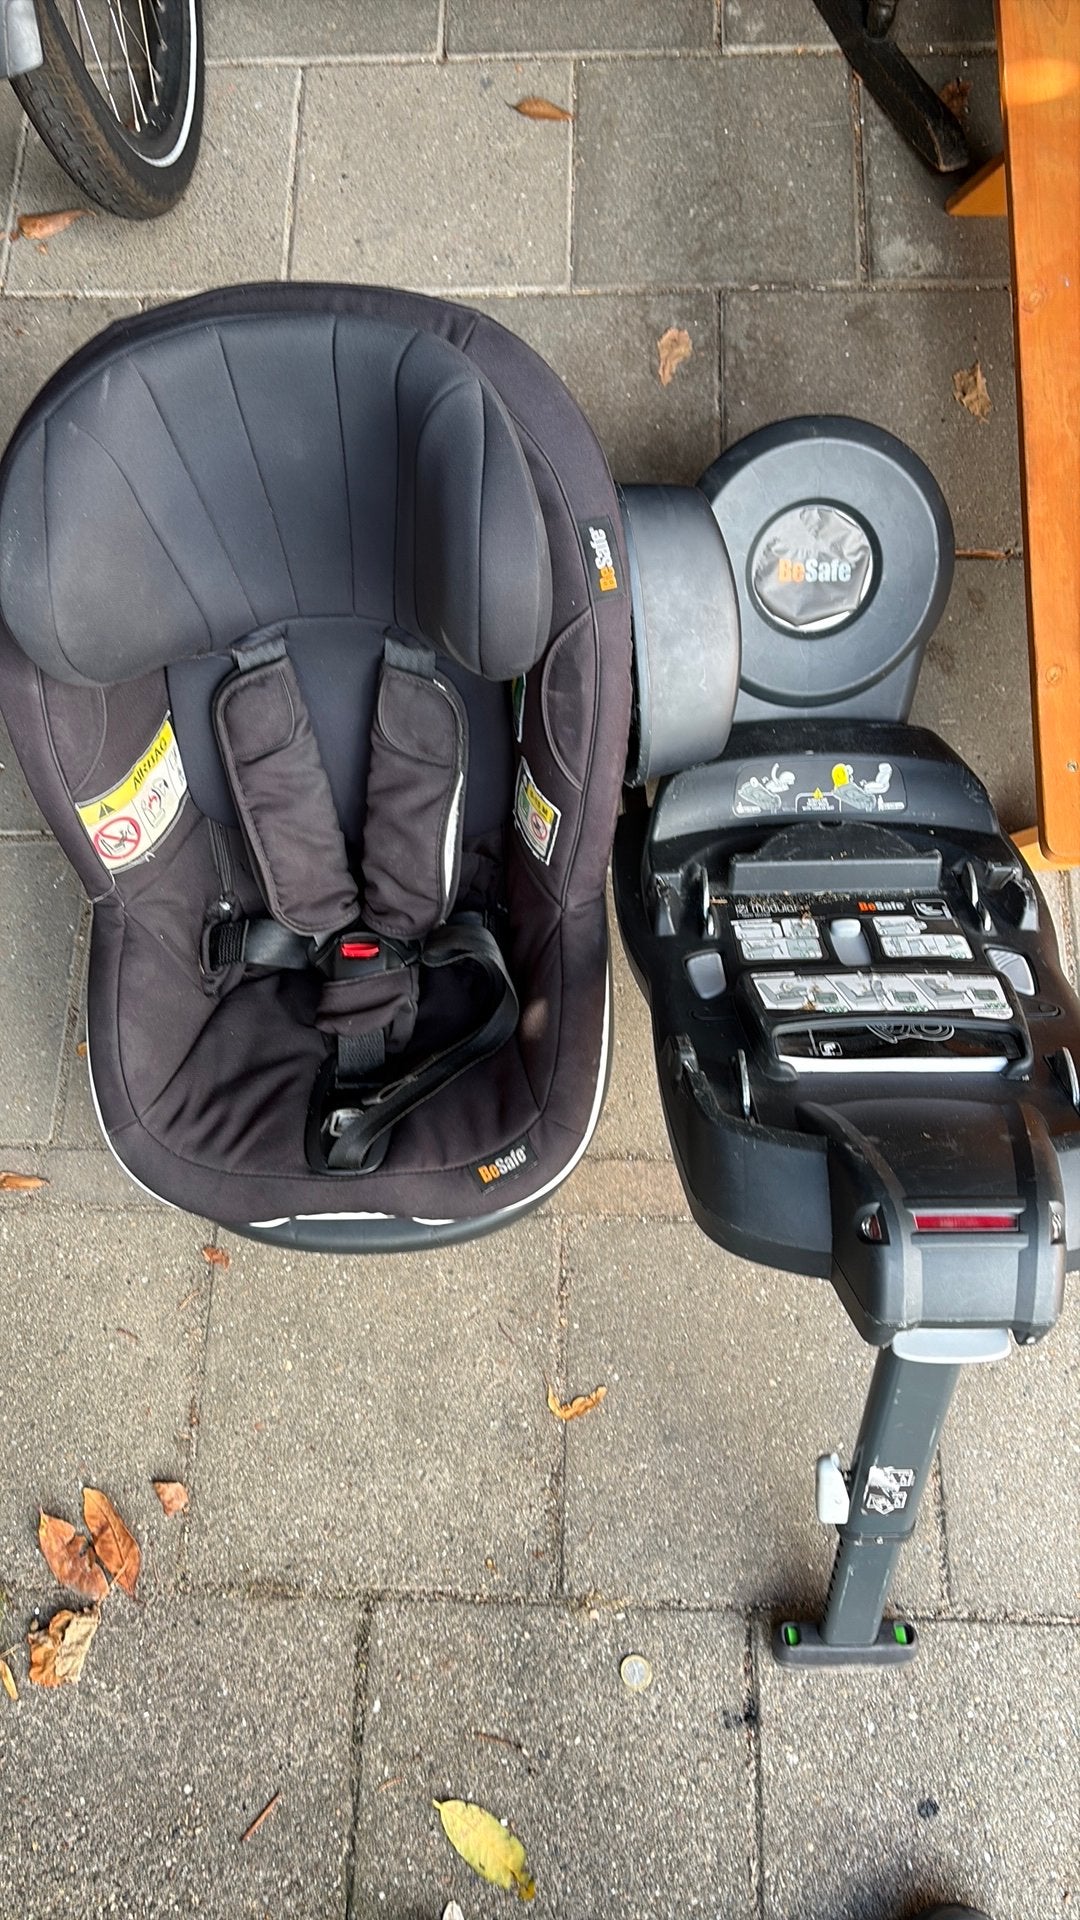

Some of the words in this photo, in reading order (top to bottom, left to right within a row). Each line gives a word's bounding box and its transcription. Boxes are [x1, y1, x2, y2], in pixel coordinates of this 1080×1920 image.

[589, 526, 618, 592] BeSafe
[778, 558, 852, 583] BeSafe
[858, 901, 906, 912] BeSafe
[478, 1146, 527, 1184] BeSafe
